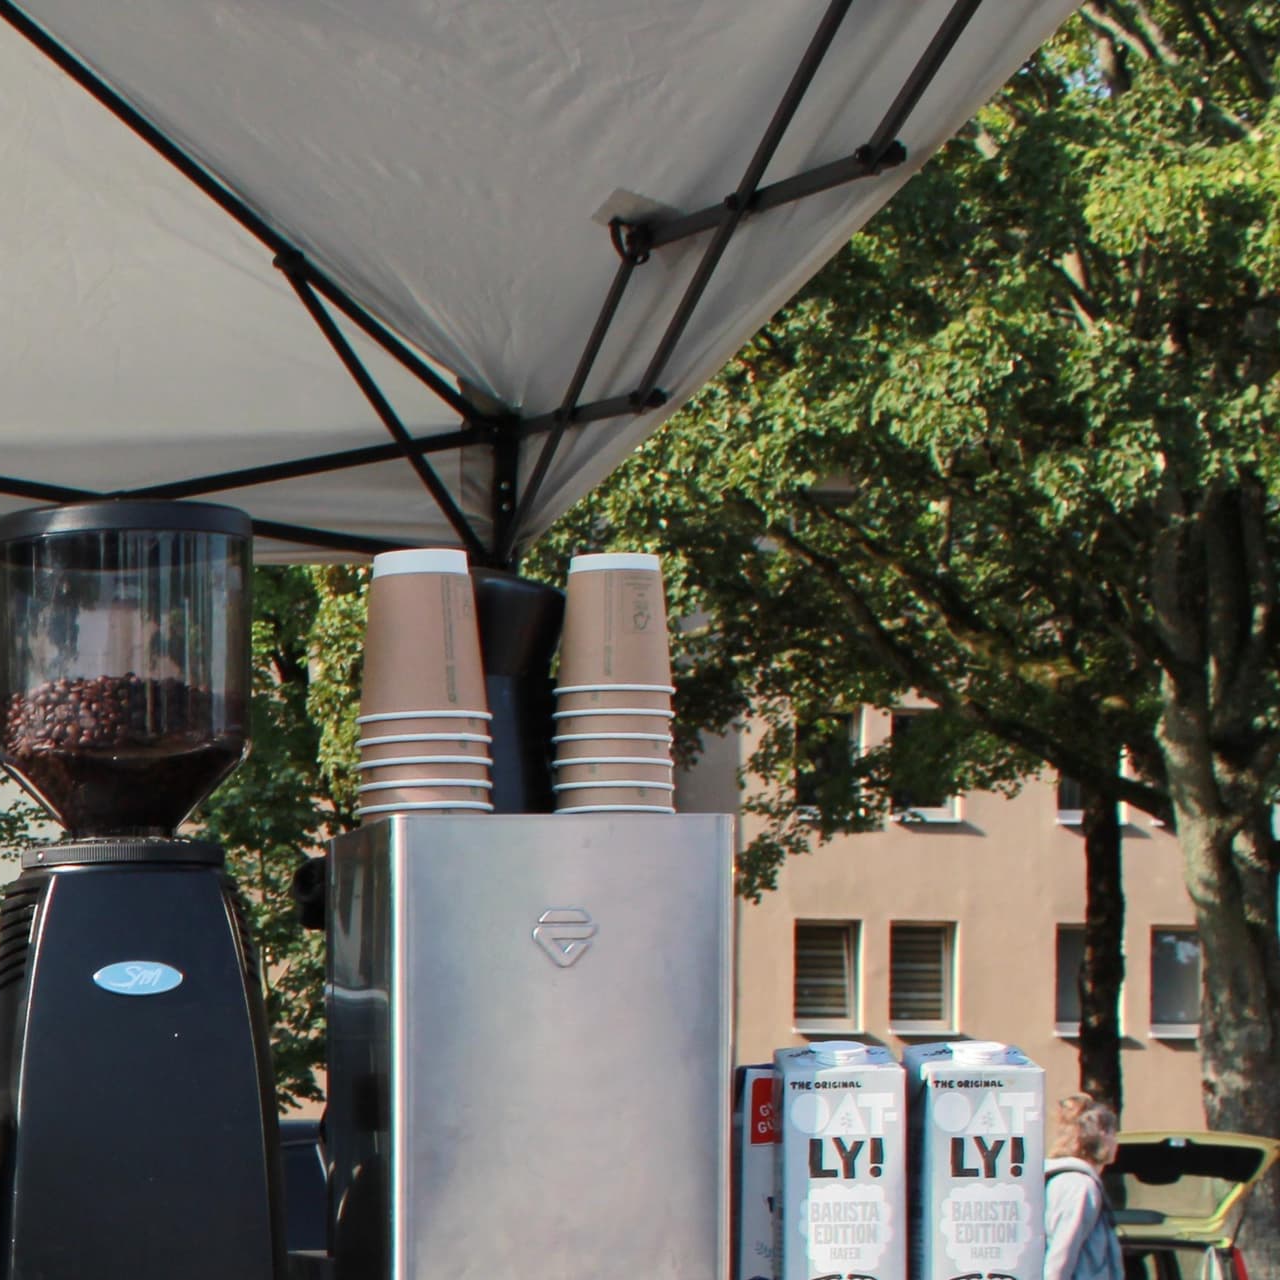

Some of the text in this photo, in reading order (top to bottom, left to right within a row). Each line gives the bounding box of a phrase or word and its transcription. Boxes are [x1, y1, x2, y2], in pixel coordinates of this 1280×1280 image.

[789, 1081, 862, 1090] THE ORIGINAL
[933, 1080, 1004, 1088] THE ORIGINAL
[808, 1137, 884, 1179] LY!
[950, 1136, 1025, 1178] LY!
[810, 1201, 880, 1222] BARISTA
[951, 1200, 1019, 1222] BARISTA
[814, 1224, 878, 1245] EDITION
[955, 1222, 1017, 1244] EDITION
[830, 1246, 861, 1260] HAFER
[970, 1246, 1001, 1260] HAFER
